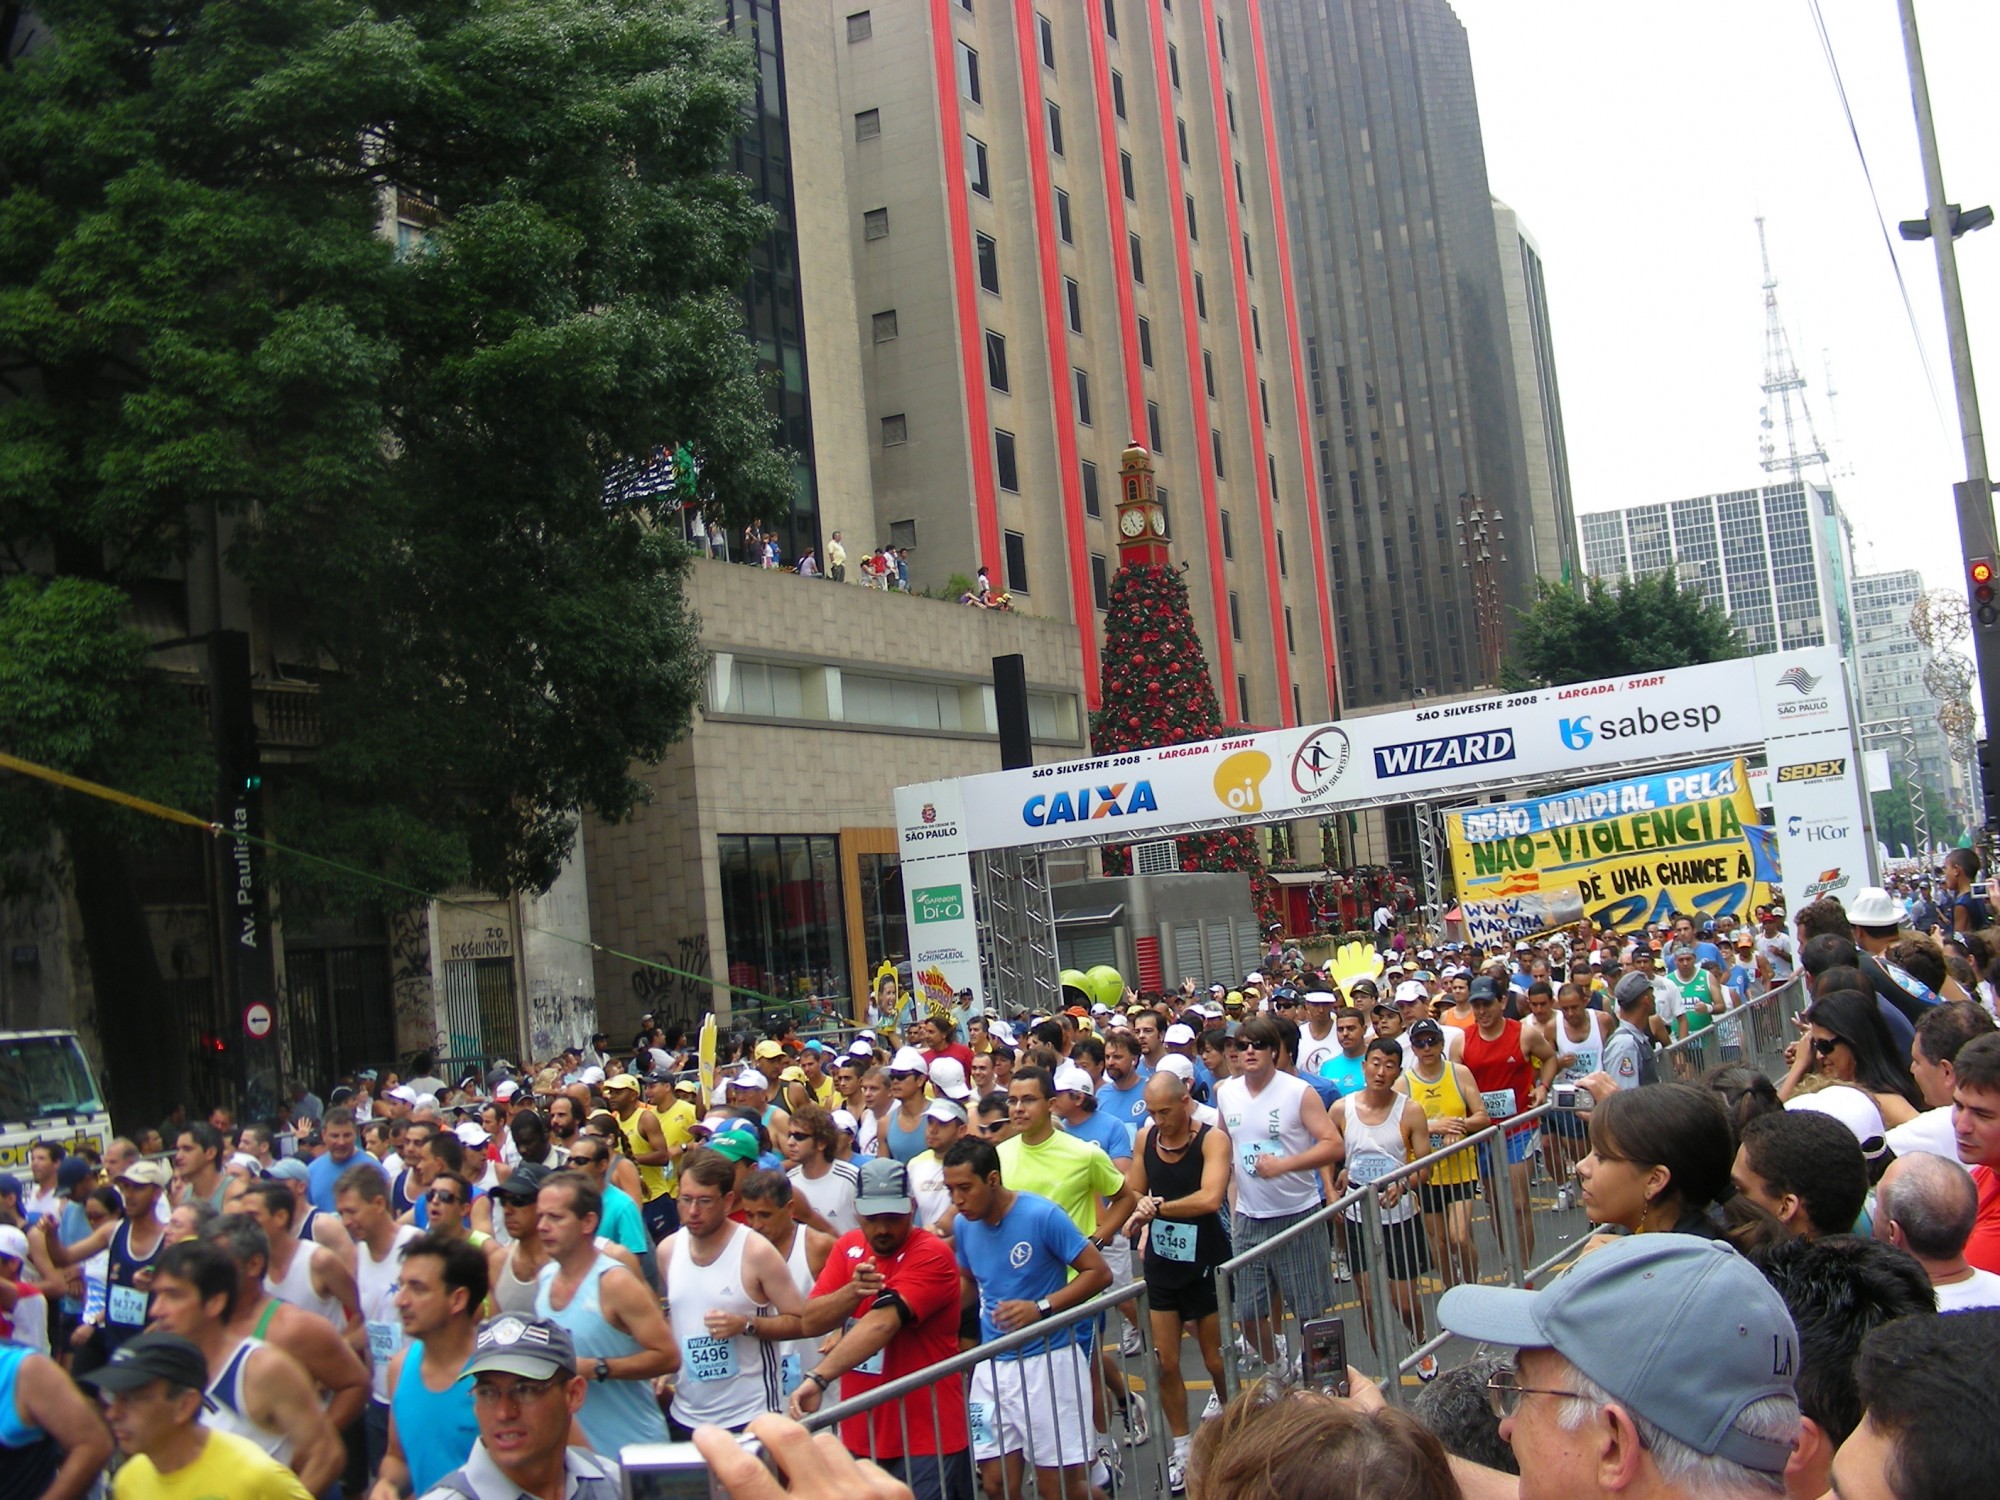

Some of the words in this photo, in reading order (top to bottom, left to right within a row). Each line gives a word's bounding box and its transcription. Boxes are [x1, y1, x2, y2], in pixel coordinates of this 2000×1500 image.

[1416, 710, 1440, 722] SÃO
[1443, 700, 1503, 719] SILVESTRE
[1507, 695, 1538, 708] 2008
[1558, 683, 1615, 700] LARGADA
[1628, 676, 1666, 690] START
[1798, 701, 1828, 712] PAULO
[1600, 704, 1722, 742] sabesp
[1032, 767, 1053, 778] SÃO
[1056, 759, 1110, 775] SILVESTRE
[1113, 755, 1140, 768] 2008
[1158, 745, 1209, 760] LARGADA
[1221, 738, 1256, 751] START
[1375, 731, 1512, 776] WIZARD
[1779, 760, 1842, 782] SEDEX
[1022, 779, 1158, 828] CAIXA
[1228, 777, 1255, 809] oi
[1538, 784, 1655, 829] MUNDIAL
[1666, 769, 1736, 804] PELA
[905, 831, 924, 842] SÃO
[926, 827, 957, 839] PAULO
[1807, 825, 1850, 842] HCor
[233, 807, 253, 905] Paulista
[1611, 865, 1652, 895] UMA
[1656, 857, 1728, 886] CHANCE
[1805, 875, 1849, 897] Gatorade
[924, 895, 957, 905] GARNIER
[241, 912, 257, 949] Av.
[1359, 1166, 1384, 1177] 5111
[1156, 1234, 1187, 1249] 12148
[692, 1346, 729, 1364] 5496
[698, 1367, 728, 1378] CAIXA
